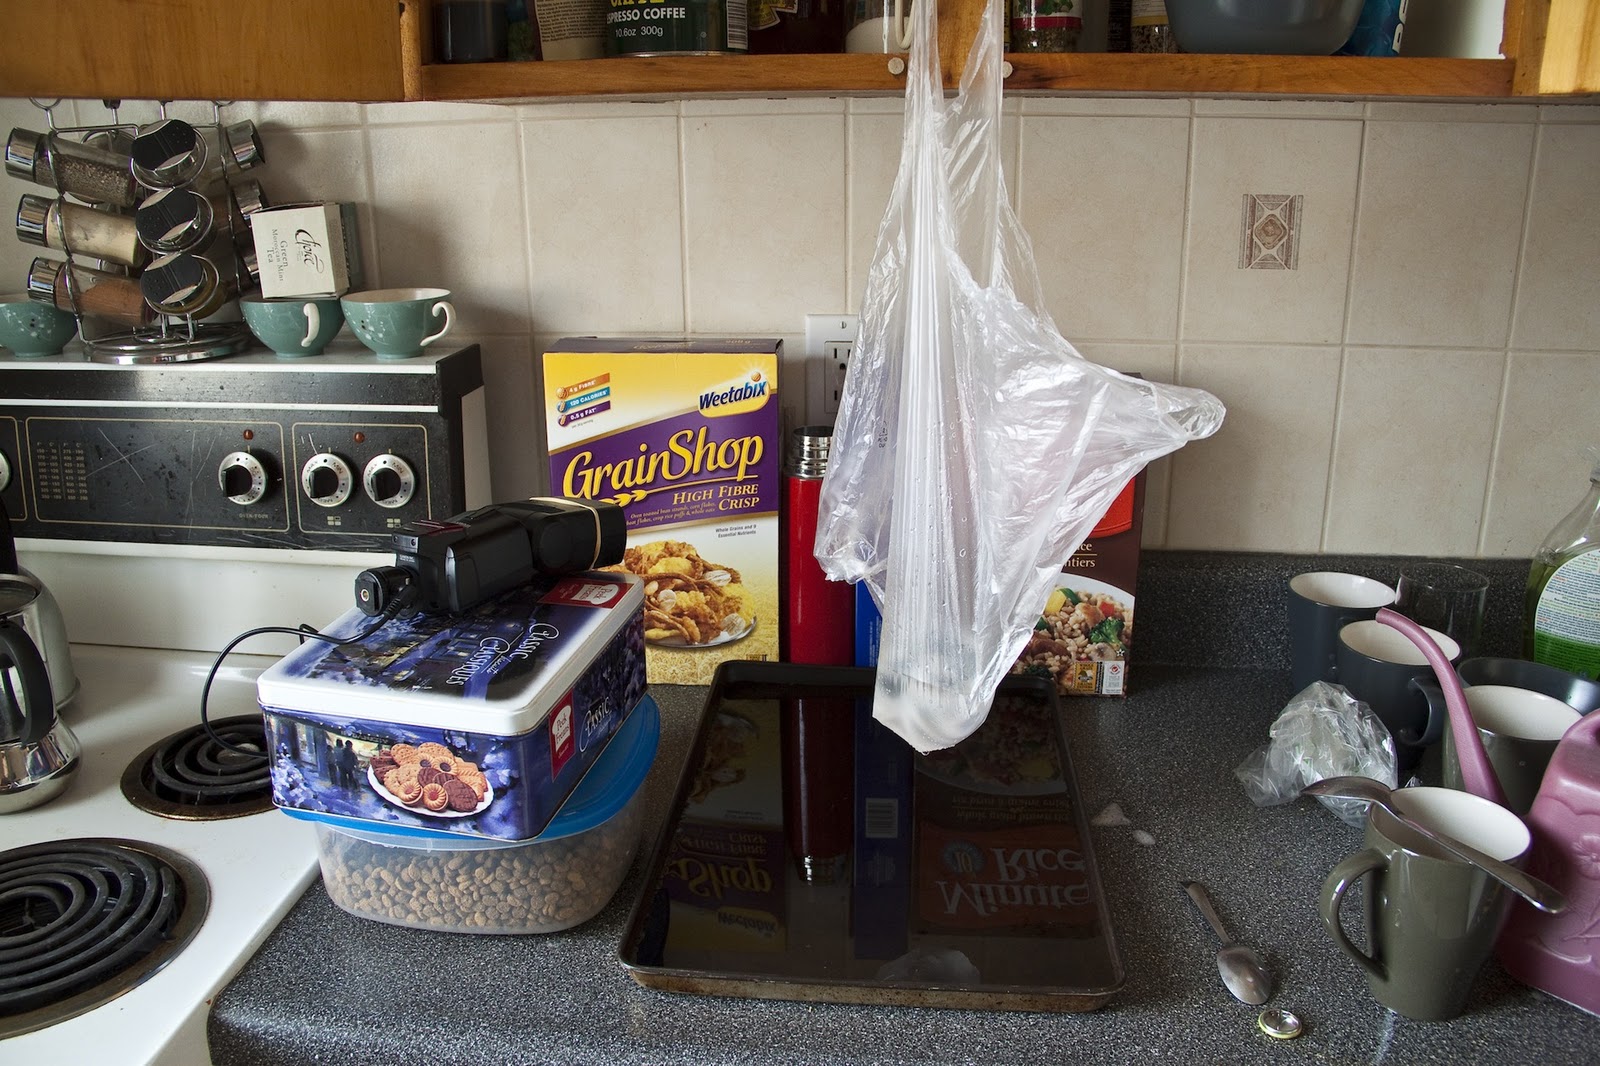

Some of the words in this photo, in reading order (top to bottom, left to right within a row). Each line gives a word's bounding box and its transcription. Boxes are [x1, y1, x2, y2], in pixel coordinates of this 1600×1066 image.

[643, 7, 686, 20] COFFEE
[640, 25, 664, 37] 300g
[266, 248, 275, 264] Tea
[280, 240, 289, 267] Green
[699, 380, 767, 410] Weetabix
[562, 425, 764, 499] GrainShop
[672, 489, 714, 505] HIGH
[718, 484, 759, 498] FIBRE
[718, 497, 760, 512] CRISP
[718, 531, 737, 539] Essential
[1064, 557, 1096, 568] ntiers
[509, 622, 560, 660] CLASSIC
[445, 636, 511, 686] CLASSIQUES
